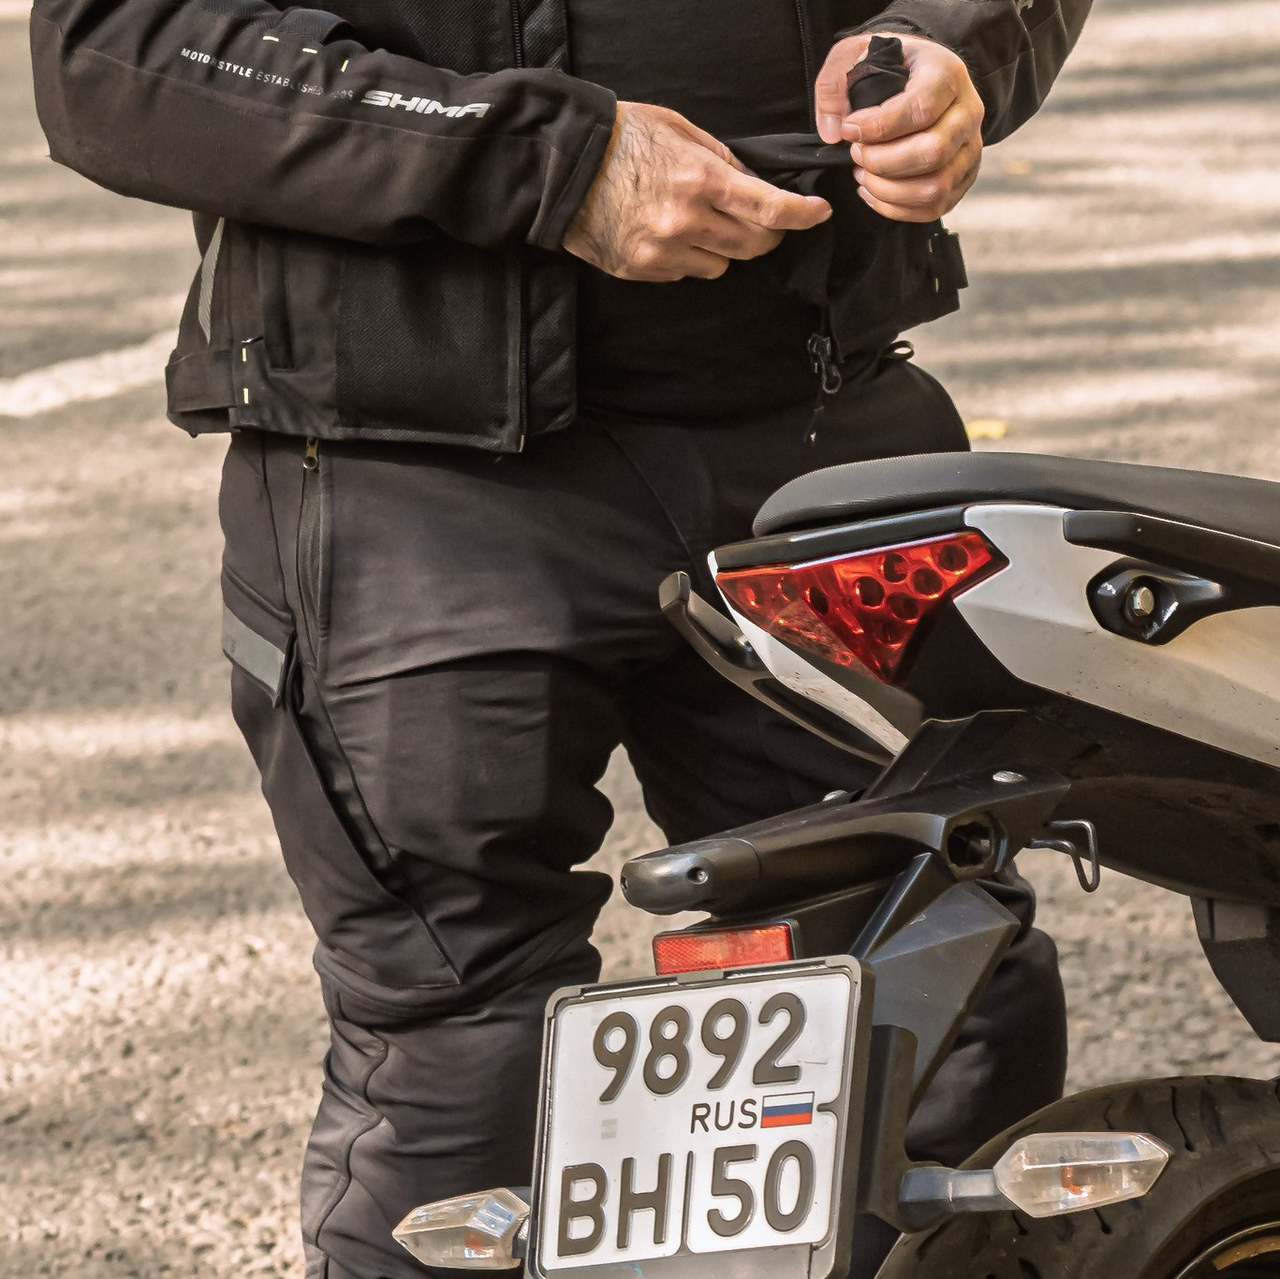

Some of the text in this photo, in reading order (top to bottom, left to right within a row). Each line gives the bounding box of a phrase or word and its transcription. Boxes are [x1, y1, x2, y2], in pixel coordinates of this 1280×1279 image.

[361, 89, 493, 118] SHIMA
[593, 991, 807, 1103] 9892
[690, 1098, 758, 1134] RUS
[706, 1139, 816, 1237] 50
